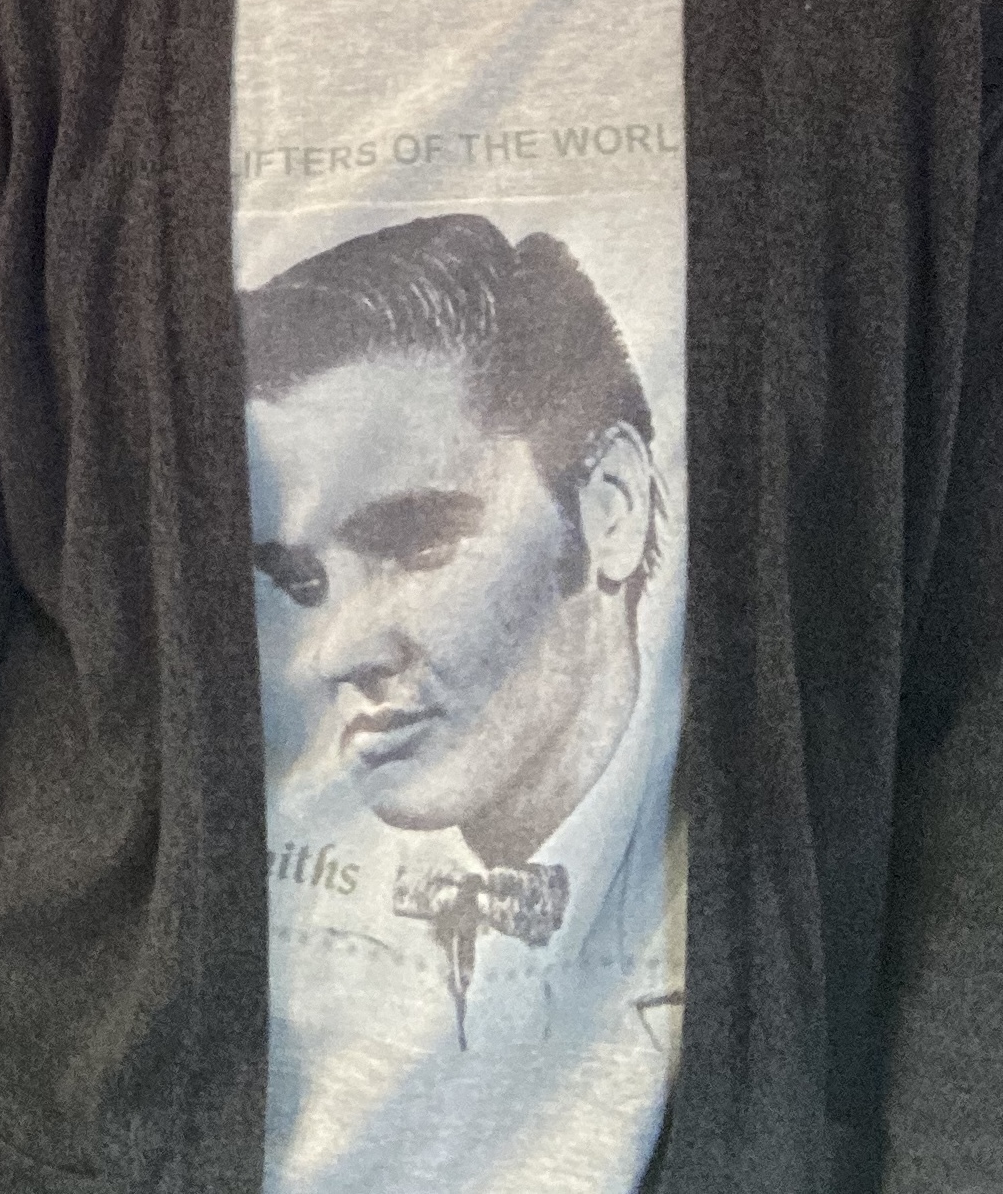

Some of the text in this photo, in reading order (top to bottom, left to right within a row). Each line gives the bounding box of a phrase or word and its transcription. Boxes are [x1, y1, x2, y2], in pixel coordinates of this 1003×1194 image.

[231, 141, 376, 178] IFTERS
[394, 132, 443, 165] OF
[457, 130, 539, 164] THE
[267, 839, 361, 896] iths
